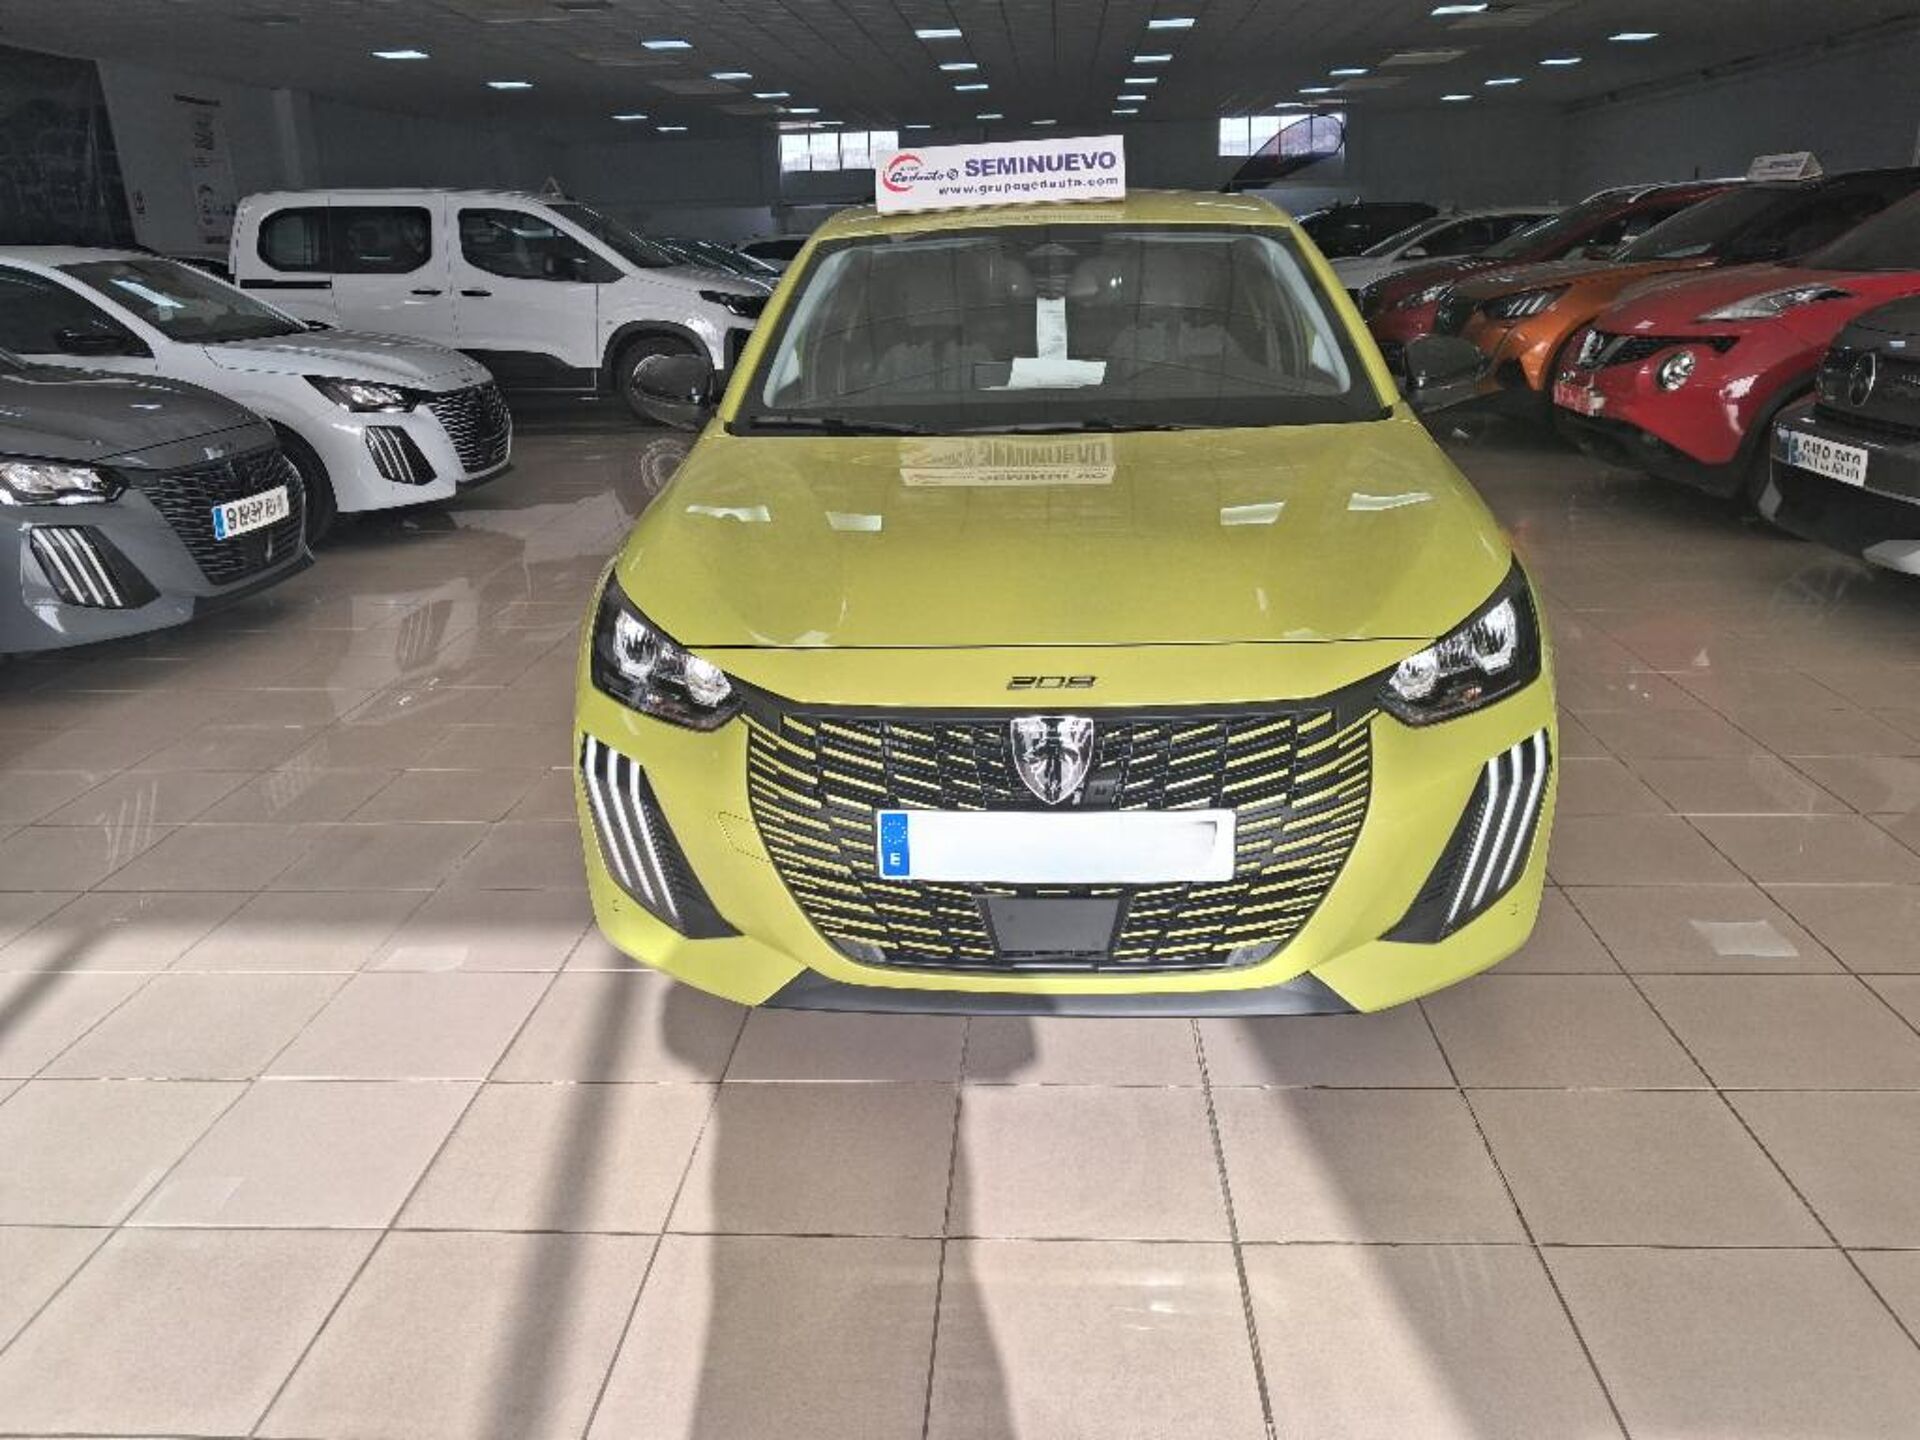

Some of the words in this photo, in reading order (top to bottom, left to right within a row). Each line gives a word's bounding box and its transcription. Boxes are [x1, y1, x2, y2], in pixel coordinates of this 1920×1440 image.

[965, 152, 1116, 177] SEMINUEVO
[1006, 676, 1097, 690] 208
[890, 853, 901, 867] E
